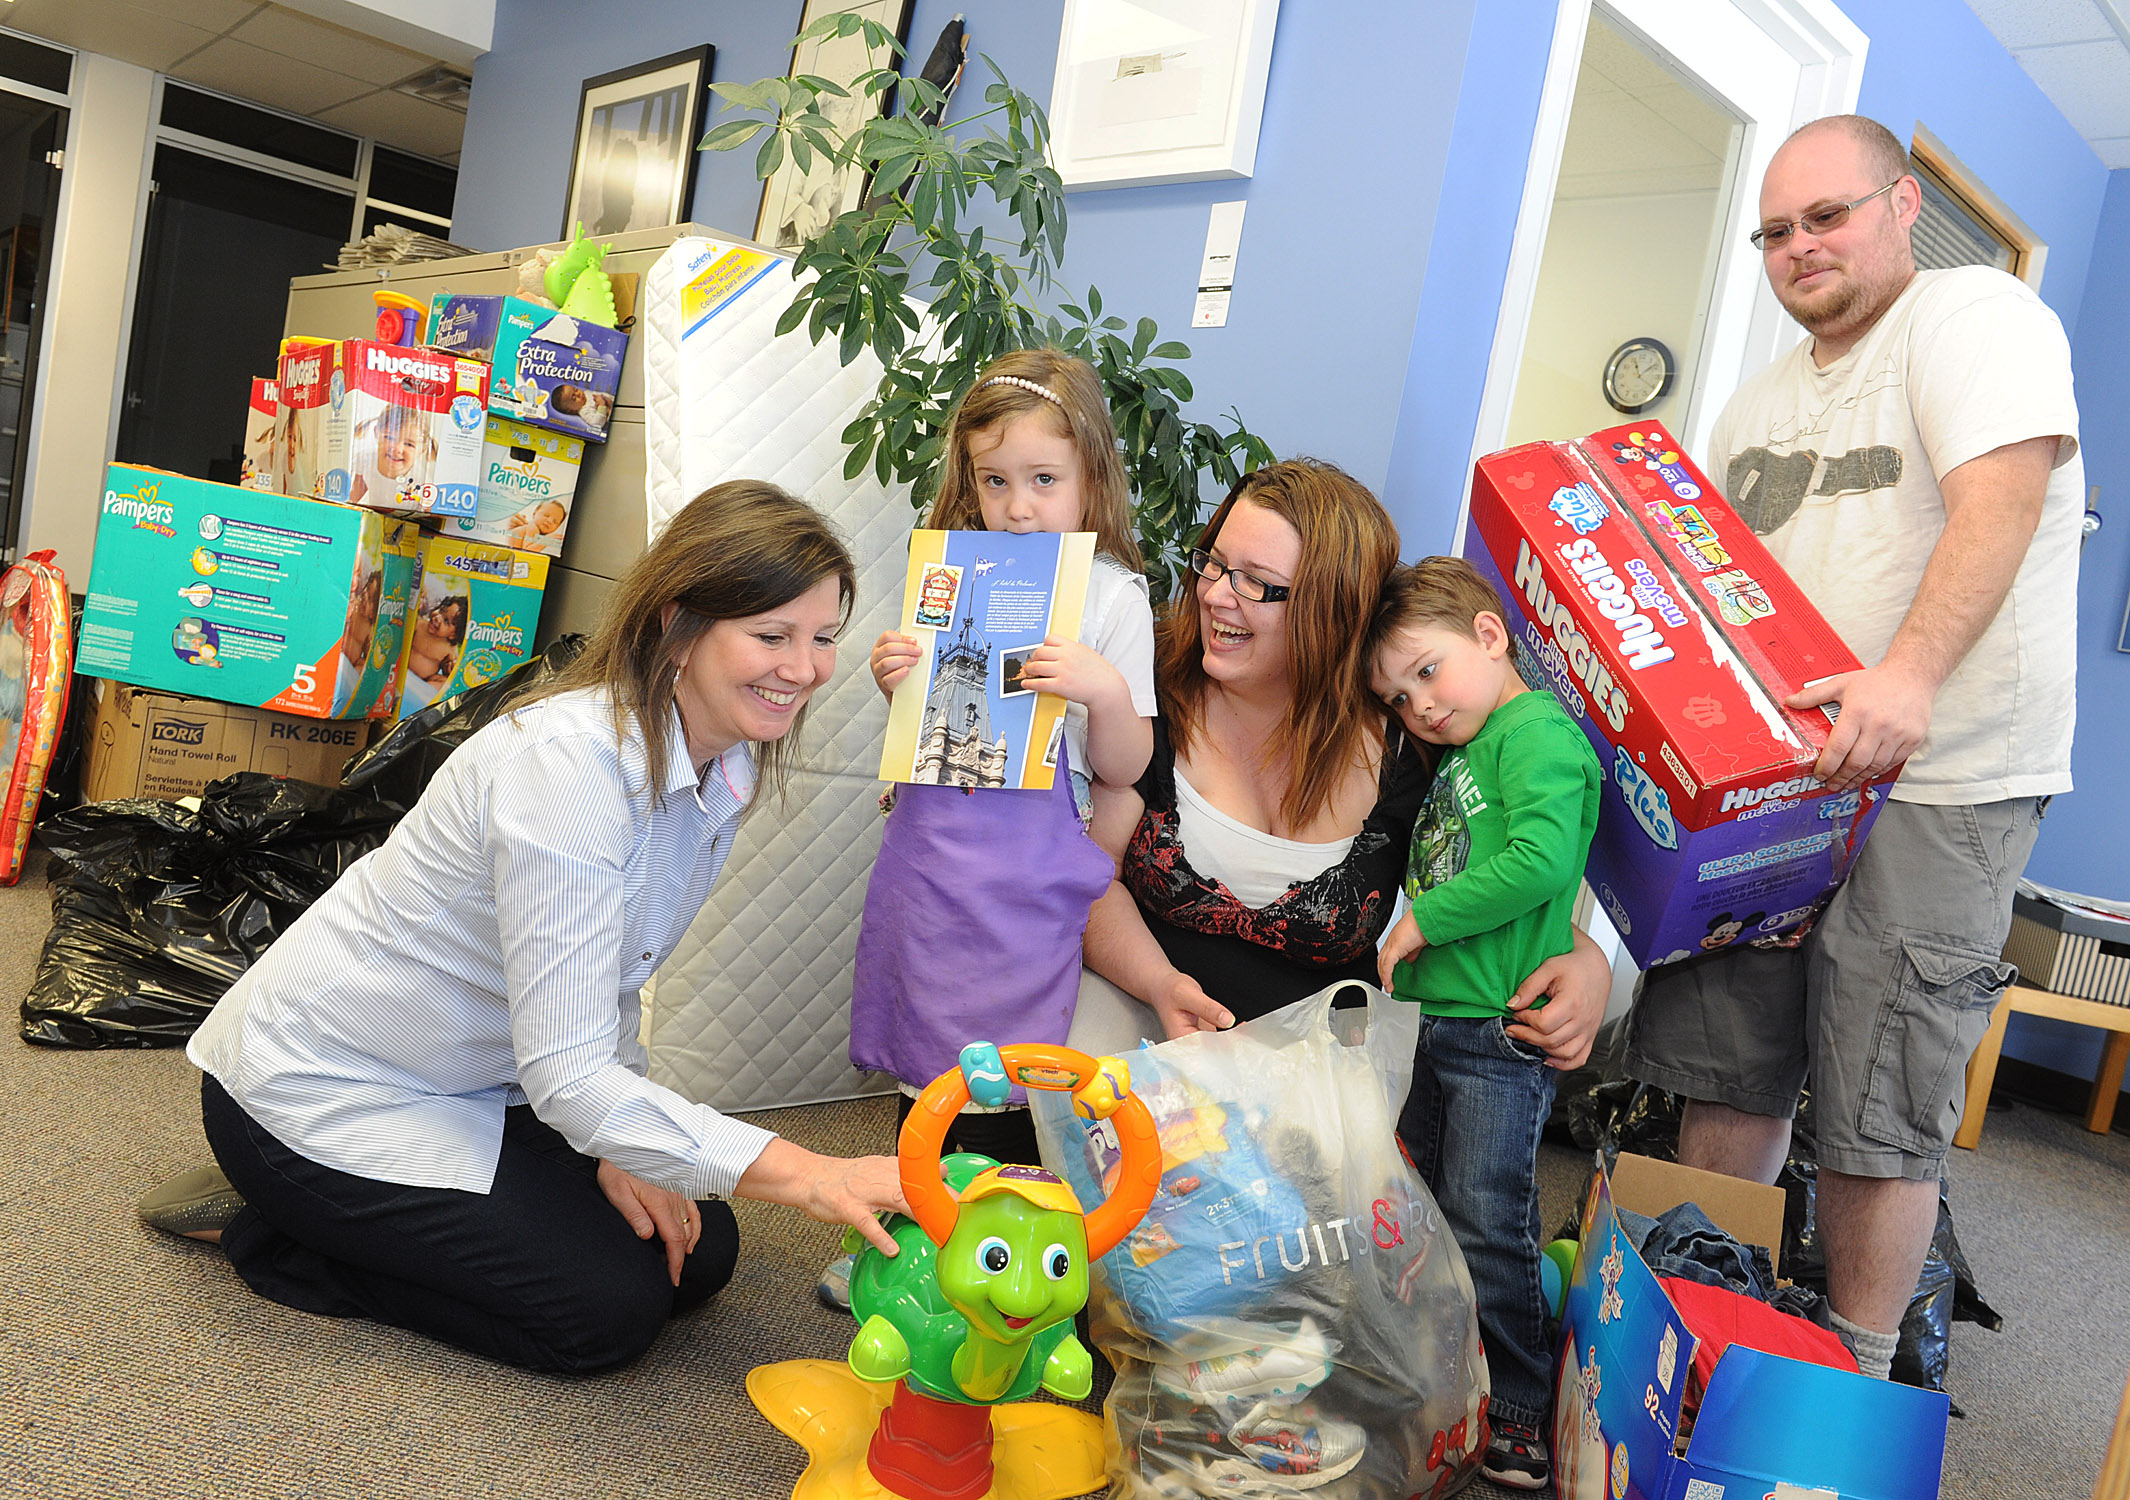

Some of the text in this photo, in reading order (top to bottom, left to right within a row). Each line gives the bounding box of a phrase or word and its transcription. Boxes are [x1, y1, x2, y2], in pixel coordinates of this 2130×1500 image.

[688, 251, 712, 272] Safety
[516, 340, 557, 362] Extra
[367, 348, 450, 383] HUGGIES
[519, 358, 593, 383] Protection
[488, 421, 499, 431] #1
[327, 475, 342, 496] 140
[1660, 467, 1679, 484] 120
[103, 490, 174, 525] Pampers
[422, 484, 432, 500] 6
[439, 487, 475, 510] 140
[1562, 490, 1601, 535] Plus
[445, 555, 471, 571] $45
[1560, 537, 1676, 671] HUGGIES
[1628, 559, 1687, 628] movers
[466, 620, 523, 648] Pampers
[1514, 537, 1629, 733] HUGGIES
[1549, 637, 1568, 671] little
[291, 663, 317, 694] 5
[388, 664, 396, 685] 5
[1527, 621, 1586, 719] movers
[152, 724, 202, 744] TORK
[270, 722, 356, 746] RK 206E
[148, 755, 176, 766] Natural
[149, 745, 237, 763] Hand Towel Roll
[144, 784, 198, 796] en Rouleau
[145, 774, 194, 787] Serviettes
[1615, 745, 1670, 842] Plus
[1720, 775, 1826, 813] HUGGIE
[1820, 791, 1861, 819] Plu
[1737, 797, 1801, 822] movers
[1697, 866, 1741, 883] Most
[1698, 853, 1753, 873] ULTRA
[1767, 907, 1810, 927] 6 120
[1371, 1198, 1405, 1250] &
[1644, 1383, 1660, 1422] 92
